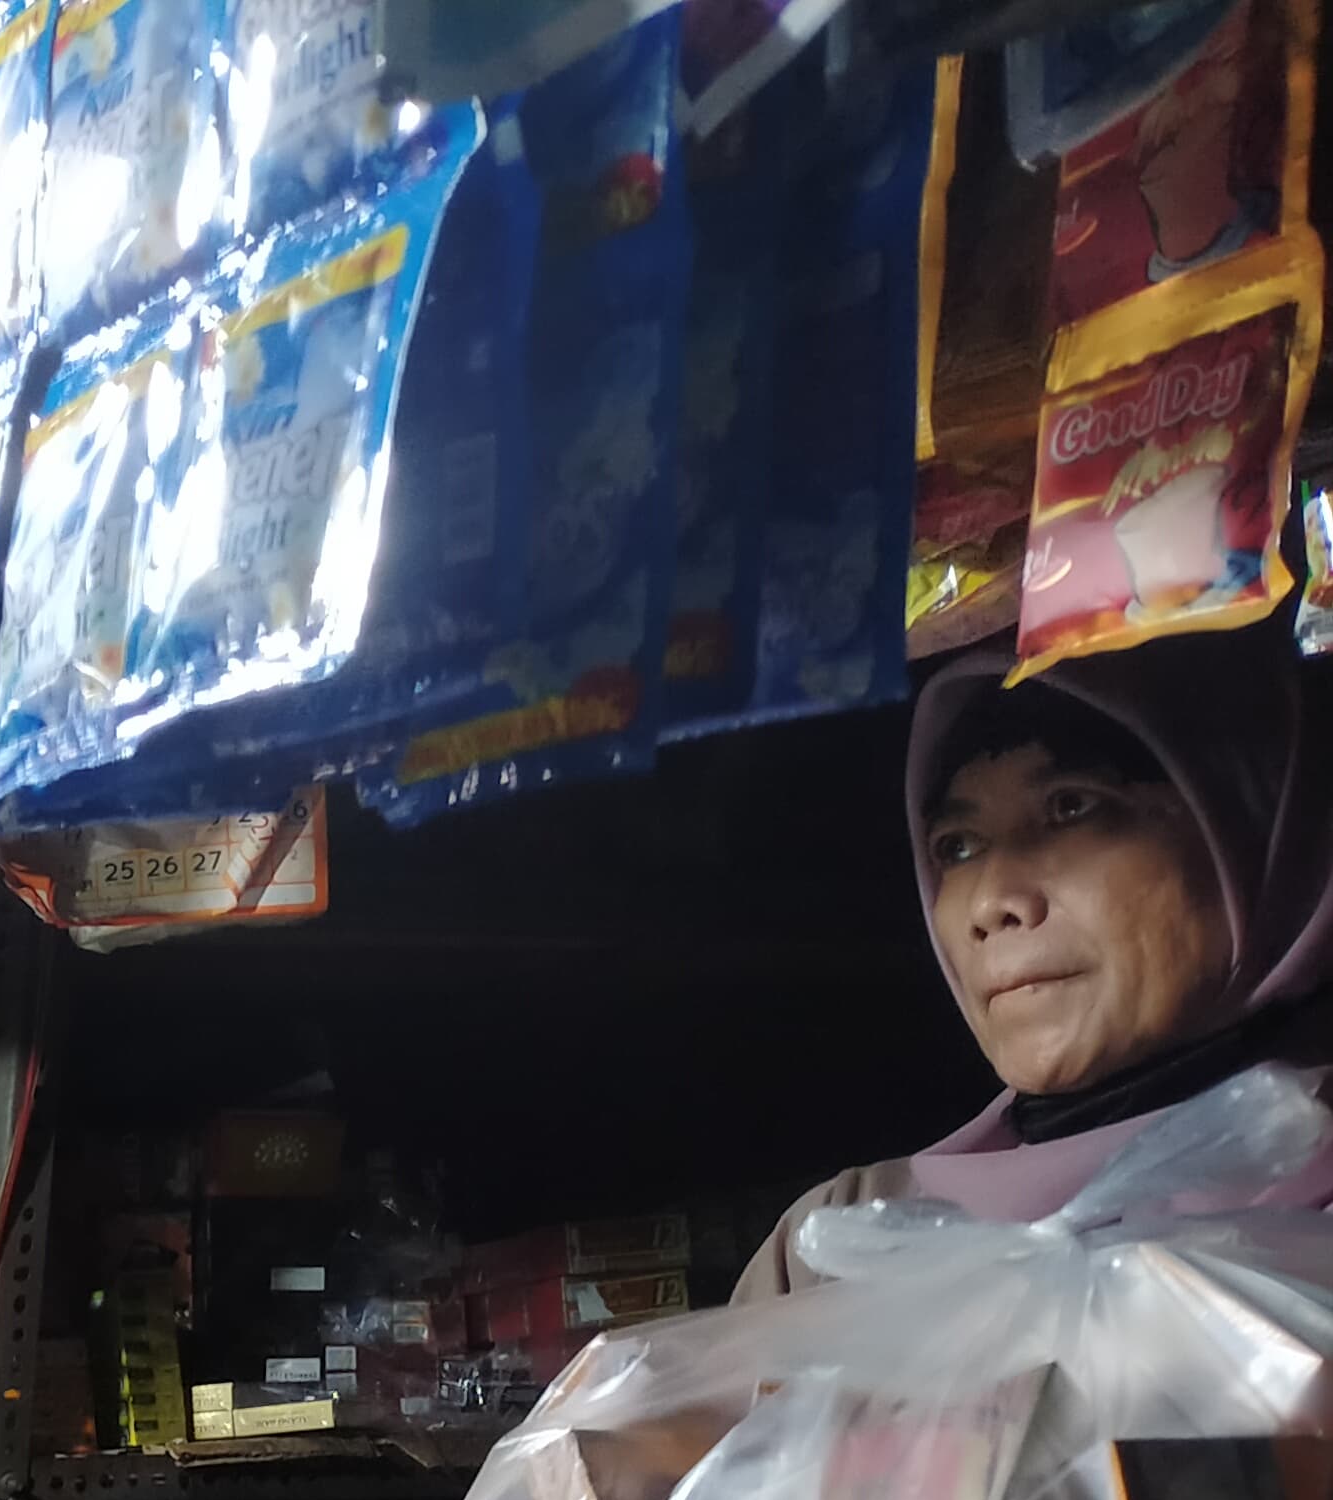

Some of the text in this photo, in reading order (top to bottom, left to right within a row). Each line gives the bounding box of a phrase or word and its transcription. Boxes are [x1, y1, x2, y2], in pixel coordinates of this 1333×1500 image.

[1050, 352, 1250, 465] Good Day
[104, 859, 135, 882] 25
[146, 856, 178, 877] 26
[191, 851, 222, 873] 27
